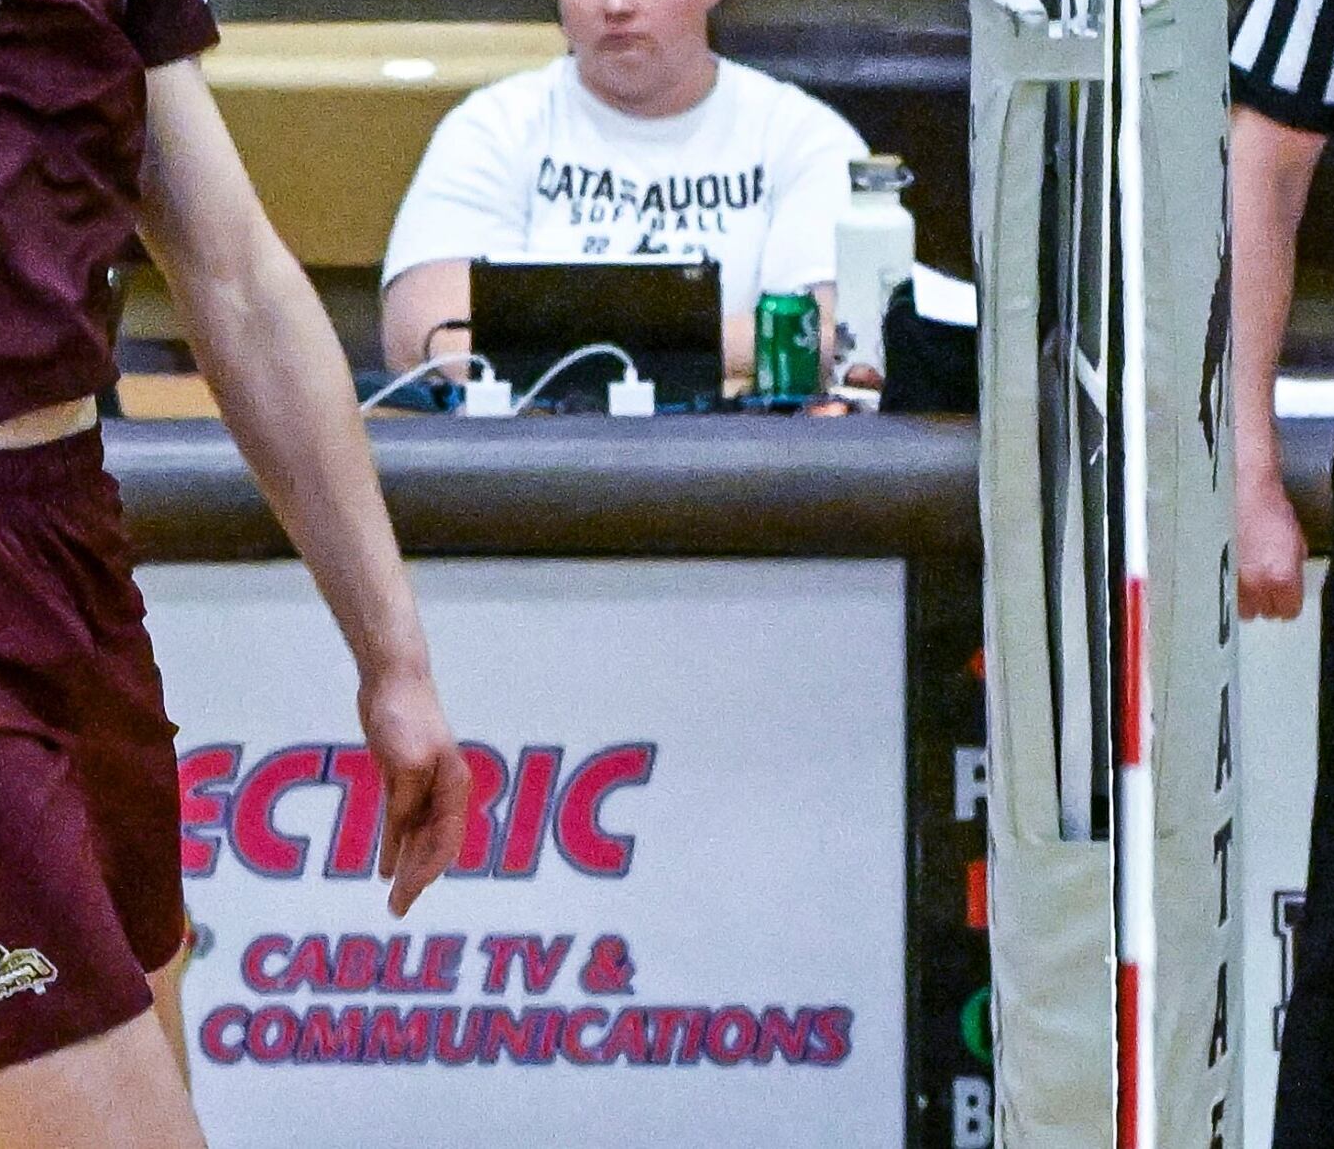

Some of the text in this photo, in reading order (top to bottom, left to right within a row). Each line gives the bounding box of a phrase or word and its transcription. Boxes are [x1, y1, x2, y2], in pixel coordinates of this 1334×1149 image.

[240, 933, 634, 995] CABLE TV &
[199, 1004, 854, 1065] COMMUNICATIONS
